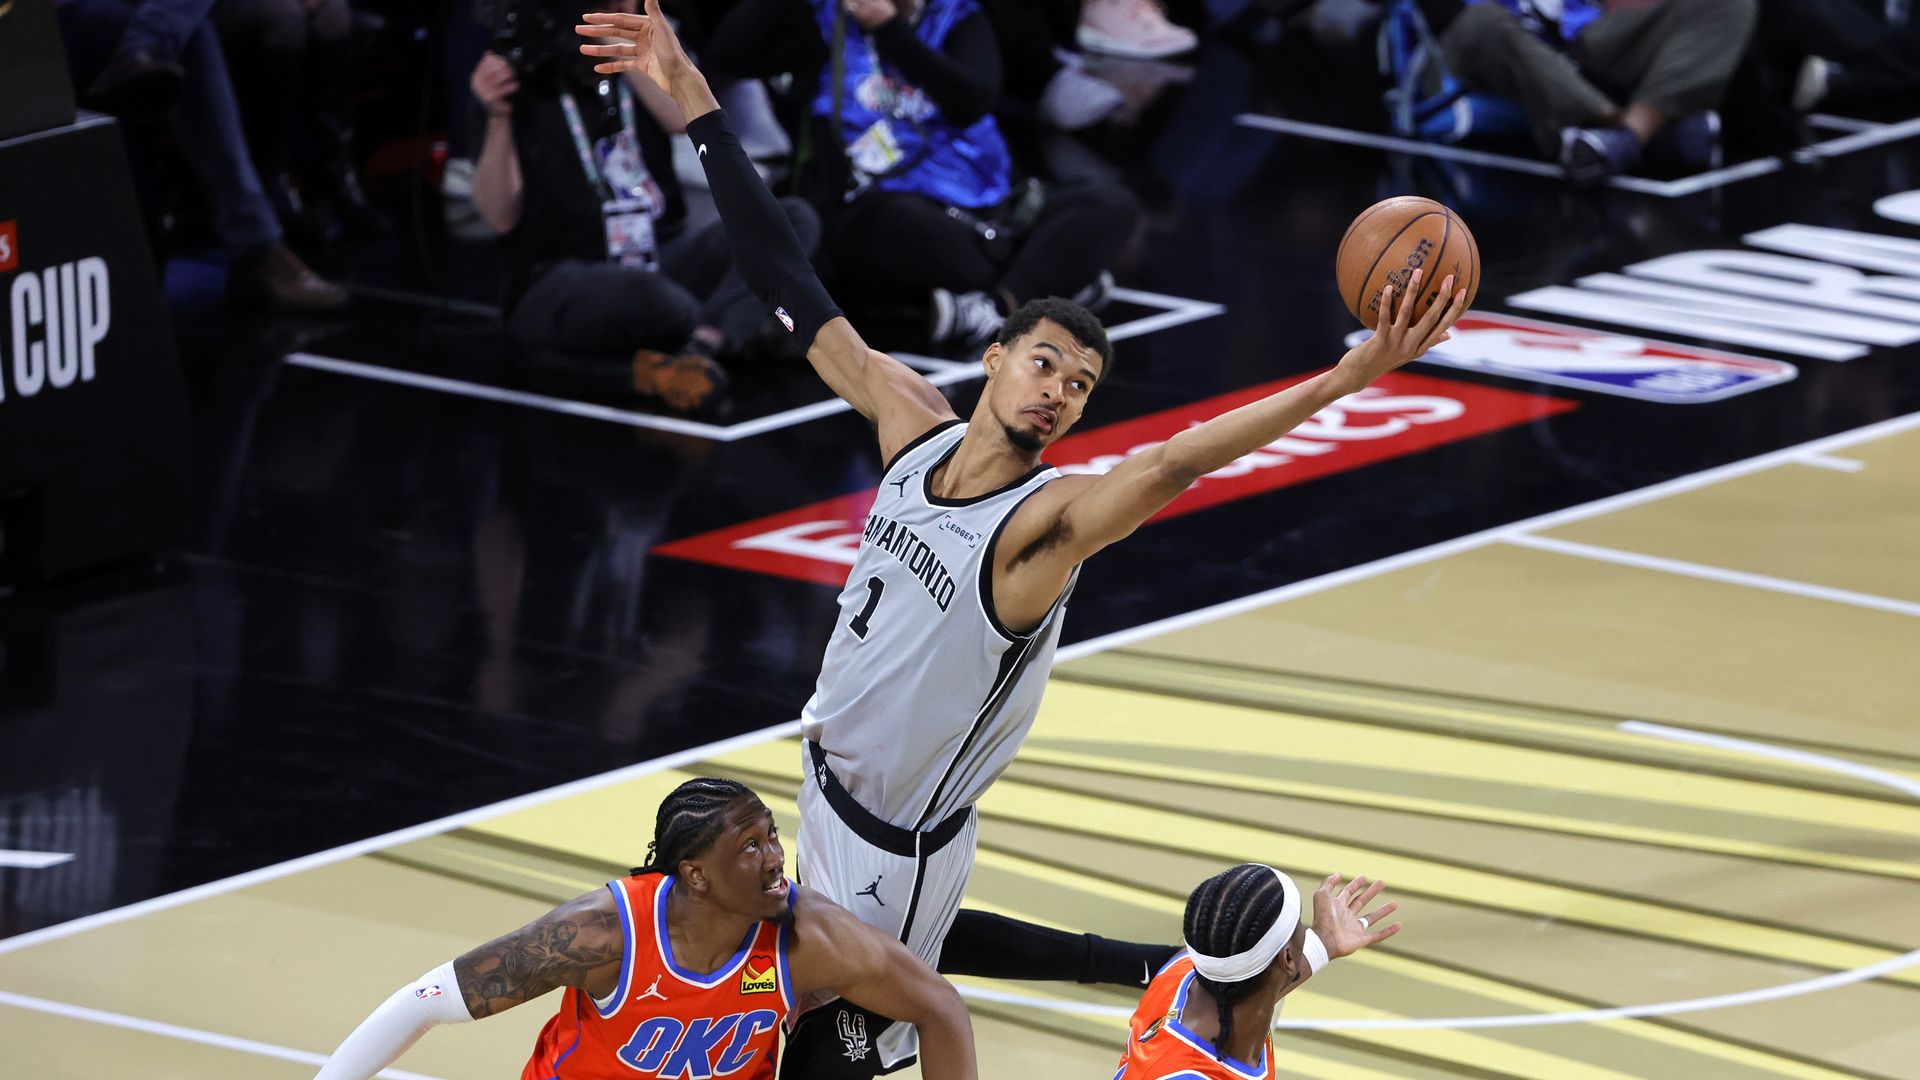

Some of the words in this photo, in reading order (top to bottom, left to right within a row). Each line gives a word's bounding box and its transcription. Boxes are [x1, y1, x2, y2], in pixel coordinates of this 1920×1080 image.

[10, 255, 111, 397] CUP
[945, 521, 975, 542] LEDGER
[848, 574, 886, 641] 1
[616, 1008, 778, 1080] OKC
